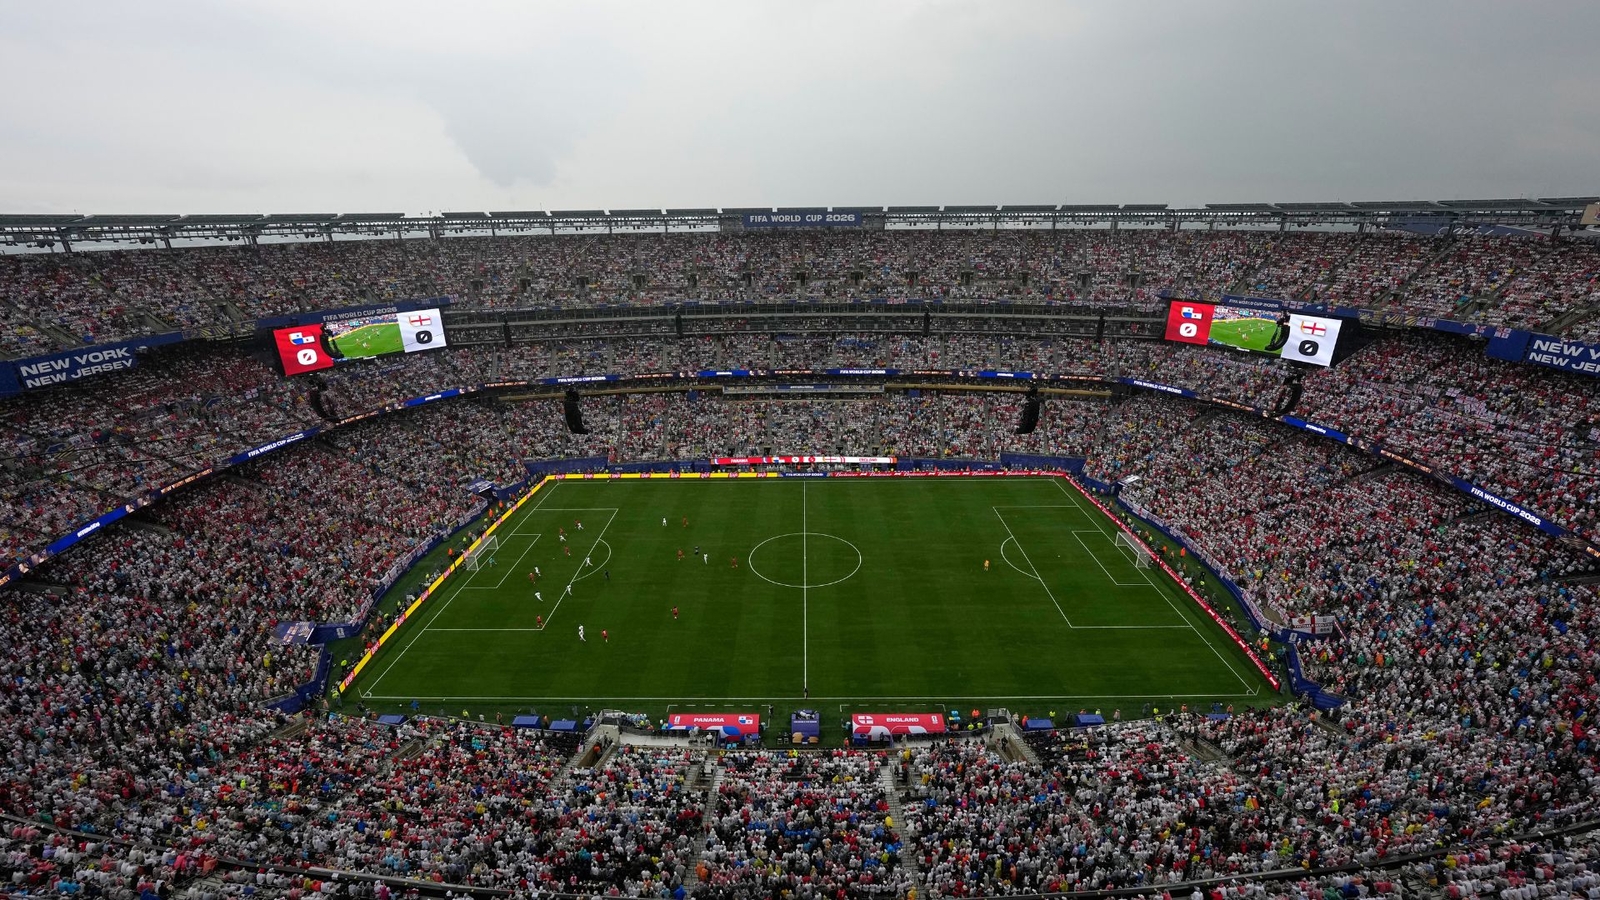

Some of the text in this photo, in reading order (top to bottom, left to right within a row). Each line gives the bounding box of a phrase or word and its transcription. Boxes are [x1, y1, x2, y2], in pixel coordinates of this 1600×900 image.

[20, 347, 130, 376] NEW YORK
[1529, 352, 1570, 367] NEW
[1533, 340, 1584, 357] NEW
[25, 359, 133, 389] NEW JERSEY
[1471, 487, 1541, 526] FIFA WORLD CUP 2026
